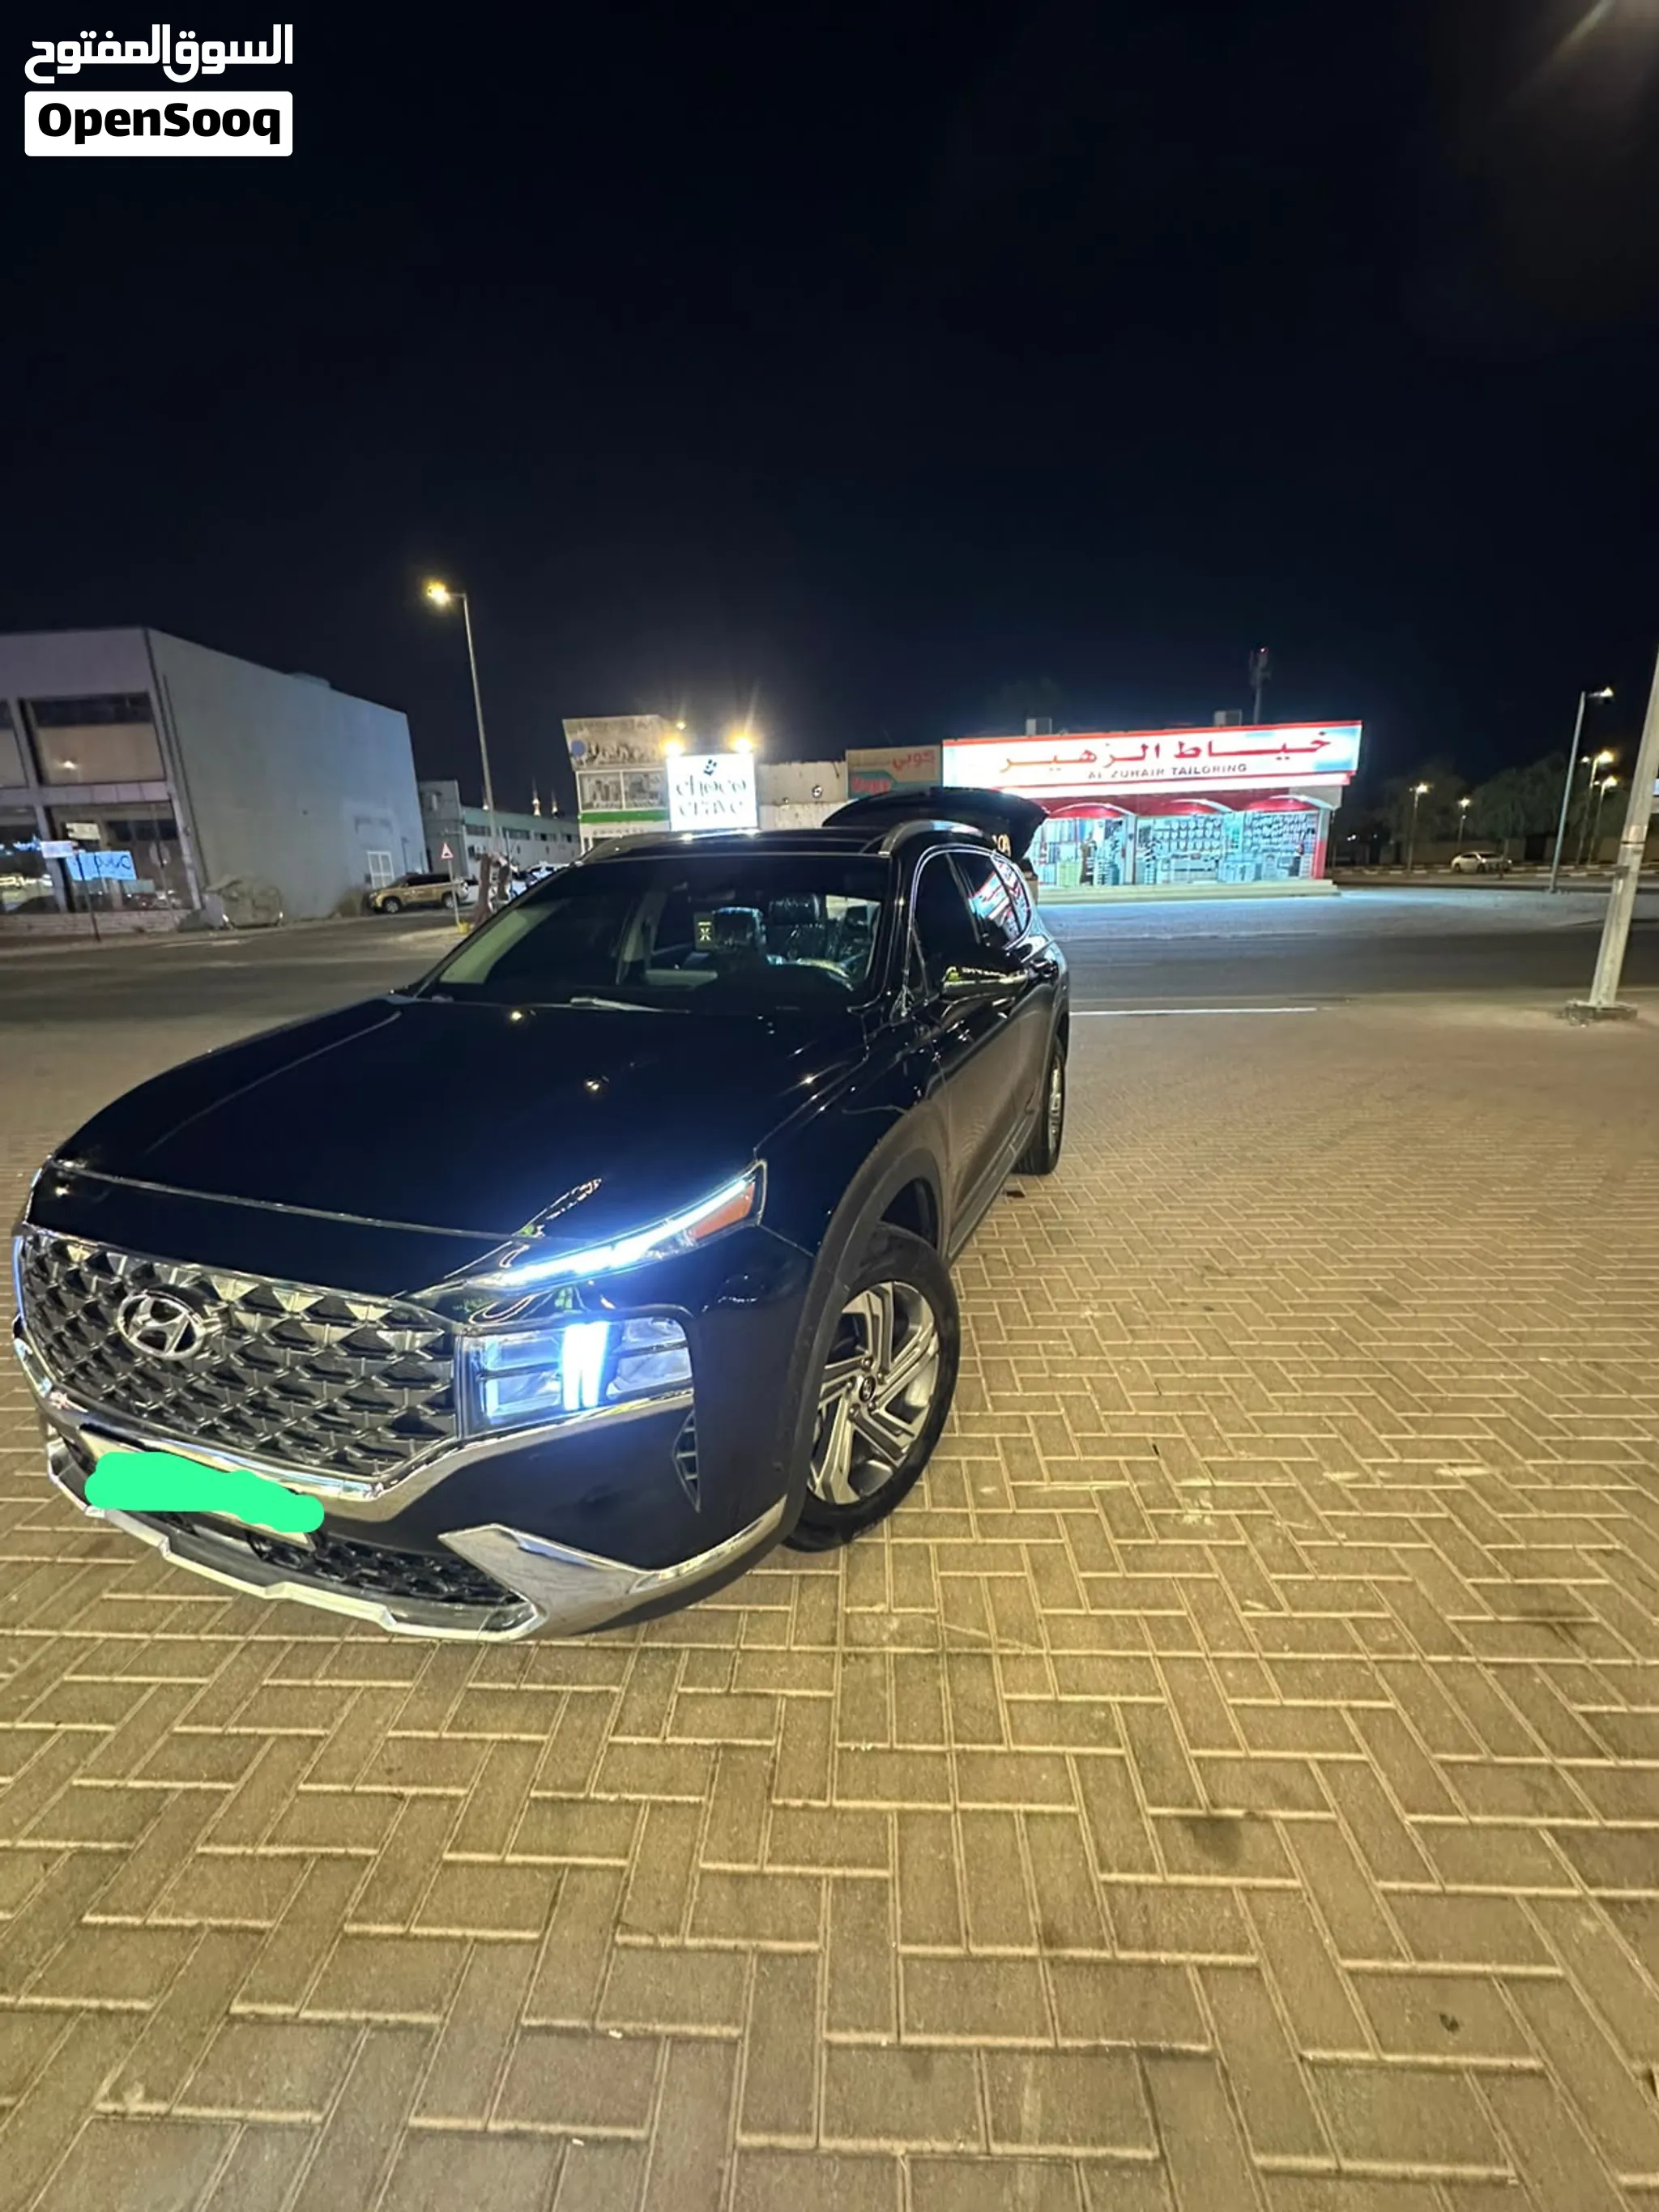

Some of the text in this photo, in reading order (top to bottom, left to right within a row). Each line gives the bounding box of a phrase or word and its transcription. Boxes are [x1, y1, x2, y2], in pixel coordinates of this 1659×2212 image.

[1000, 731, 1331, 774] خياط الزهير
[1087, 763, 1247, 780] AL ZUHAIR TAILORING
